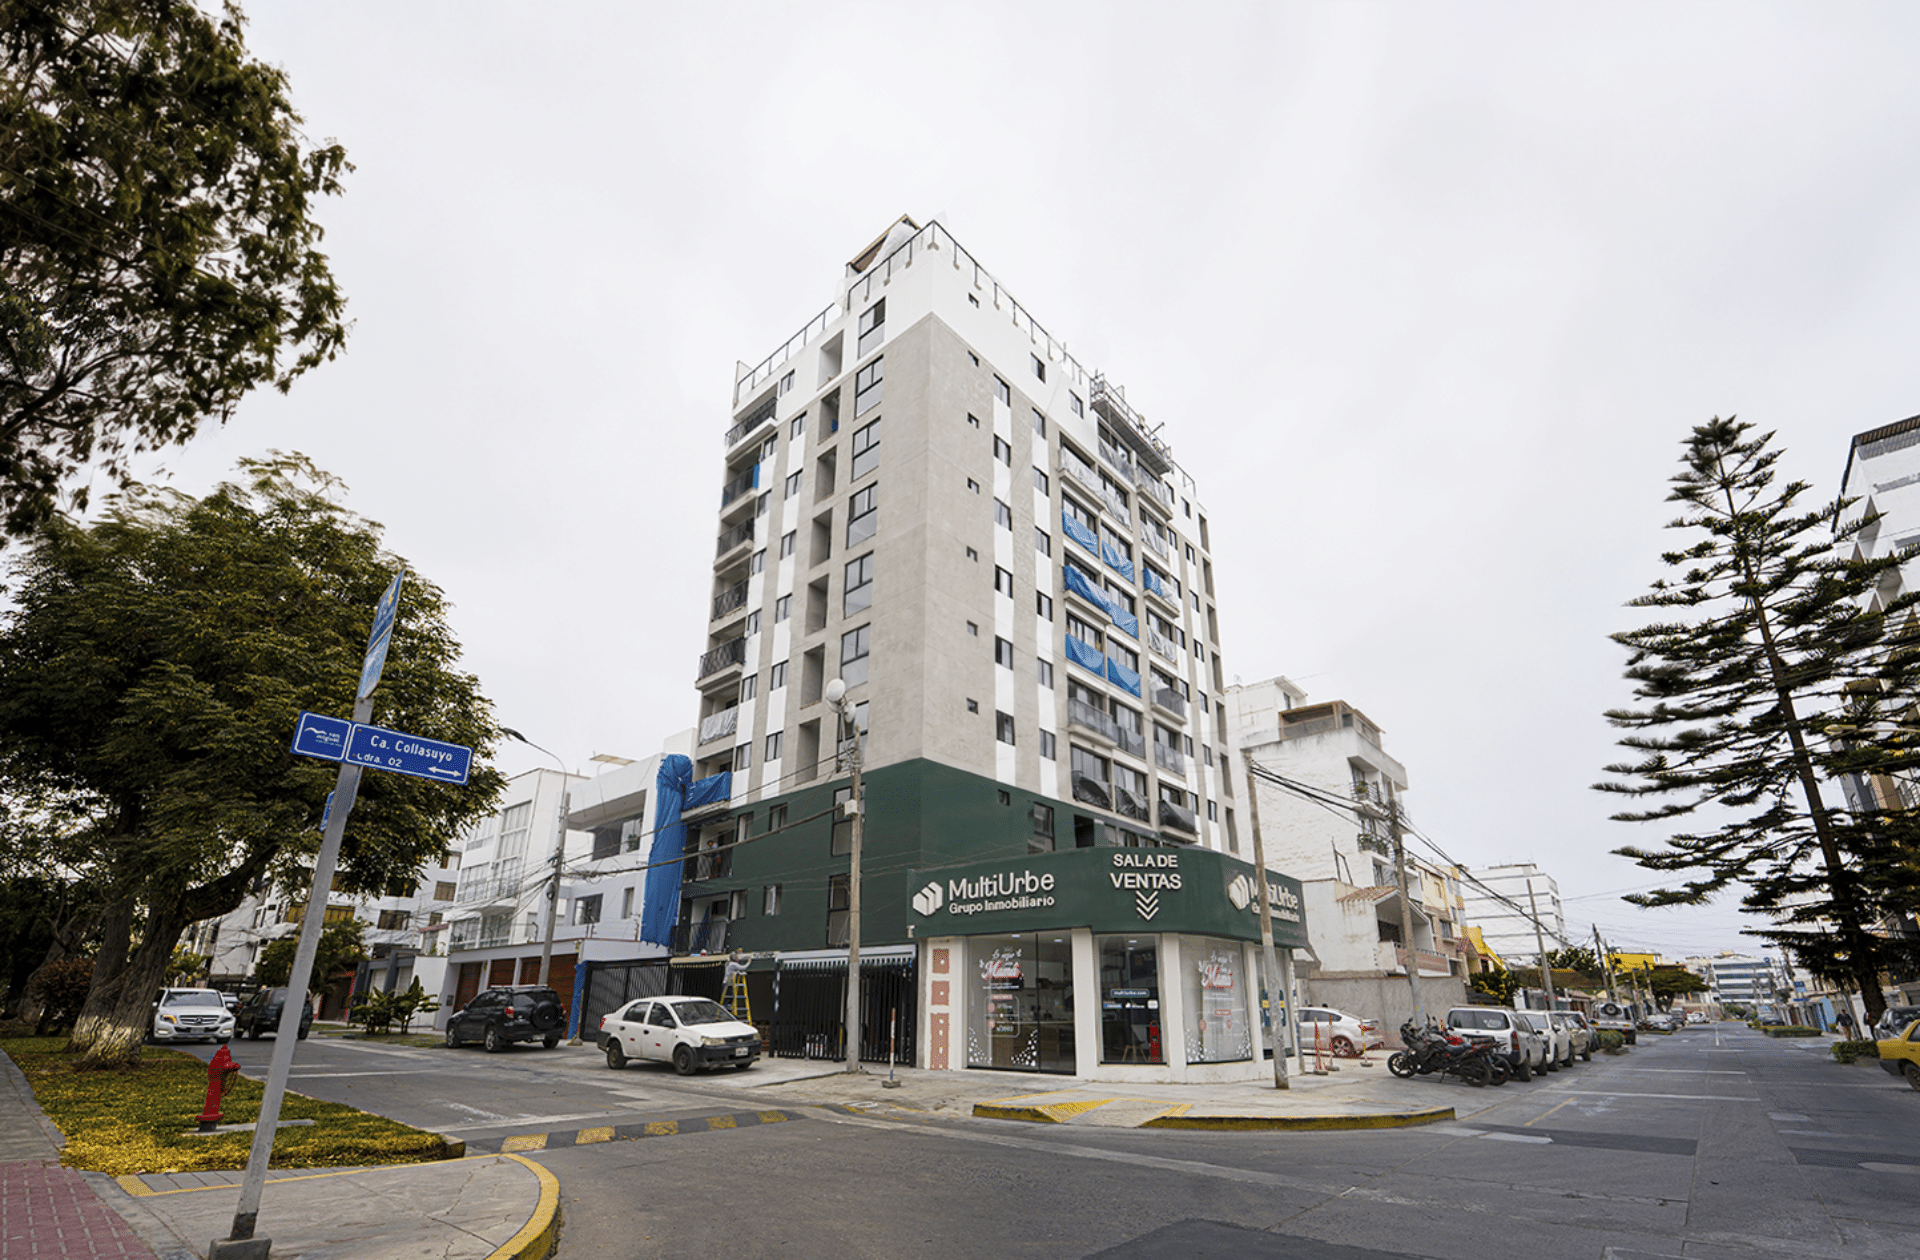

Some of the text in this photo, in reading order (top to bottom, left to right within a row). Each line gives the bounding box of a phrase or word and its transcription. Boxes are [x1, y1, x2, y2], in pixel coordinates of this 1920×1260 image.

[370, 735, 453, 763] Ca. Collasuyo
[388, 757, 403, 768] 02
[949, 870, 1055, 901] MultiUrbe
[1109, 872, 1182, 889] VENTAS
[949, 895, 1055, 915] Grupo Inmobiliario
